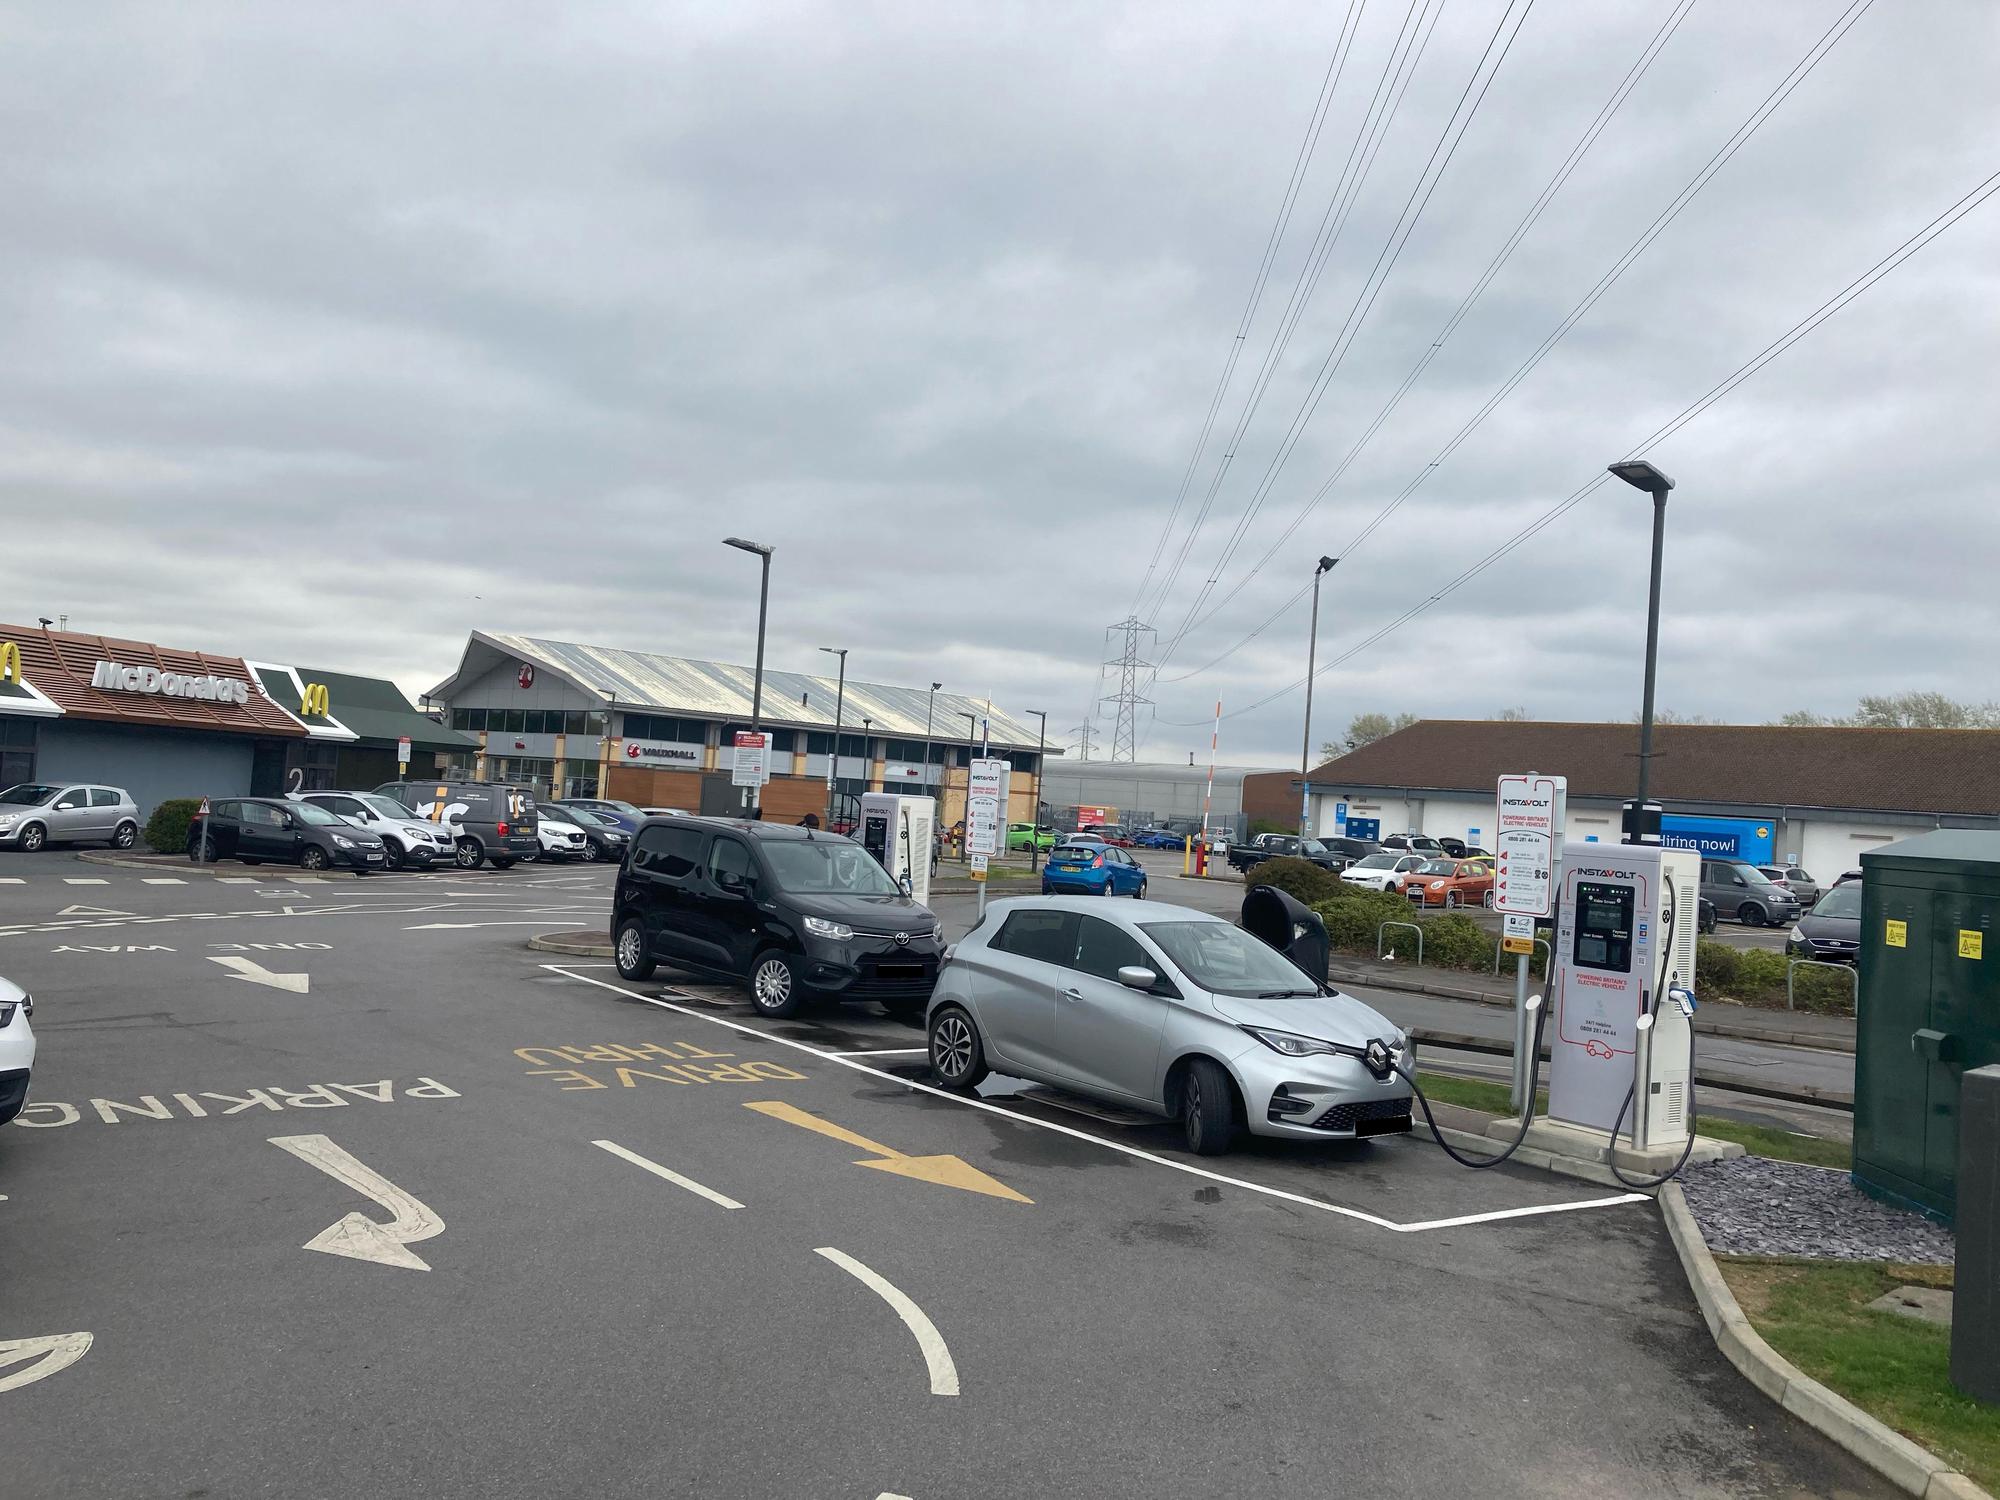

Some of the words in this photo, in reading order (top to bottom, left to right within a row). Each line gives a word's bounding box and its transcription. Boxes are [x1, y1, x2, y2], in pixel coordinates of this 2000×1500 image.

[91, 660, 249, 704] McDonald's
[642, 747, 696, 760] VAUXHALL
[1503, 799, 1549, 807] INSTAVOLT
[1660, 834, 1697, 850] Hiring
[1701, 839, 1735, 852] now!
[1577, 867, 1637, 879] INSTAVOLT
[51, 944, 177, 953] WAY
[206, 942, 333, 952] ONE
[1577, 974, 1602, 982] POWERING
[1603, 977, 1627, 985] BRITAIN'S
[1578, 979, 1600, 987] ELECTRIC
[513, 1041, 736, 1065] THRU
[526, 1061, 810, 1091] DRIVE
[13, 1077, 462, 1128] PARKING
